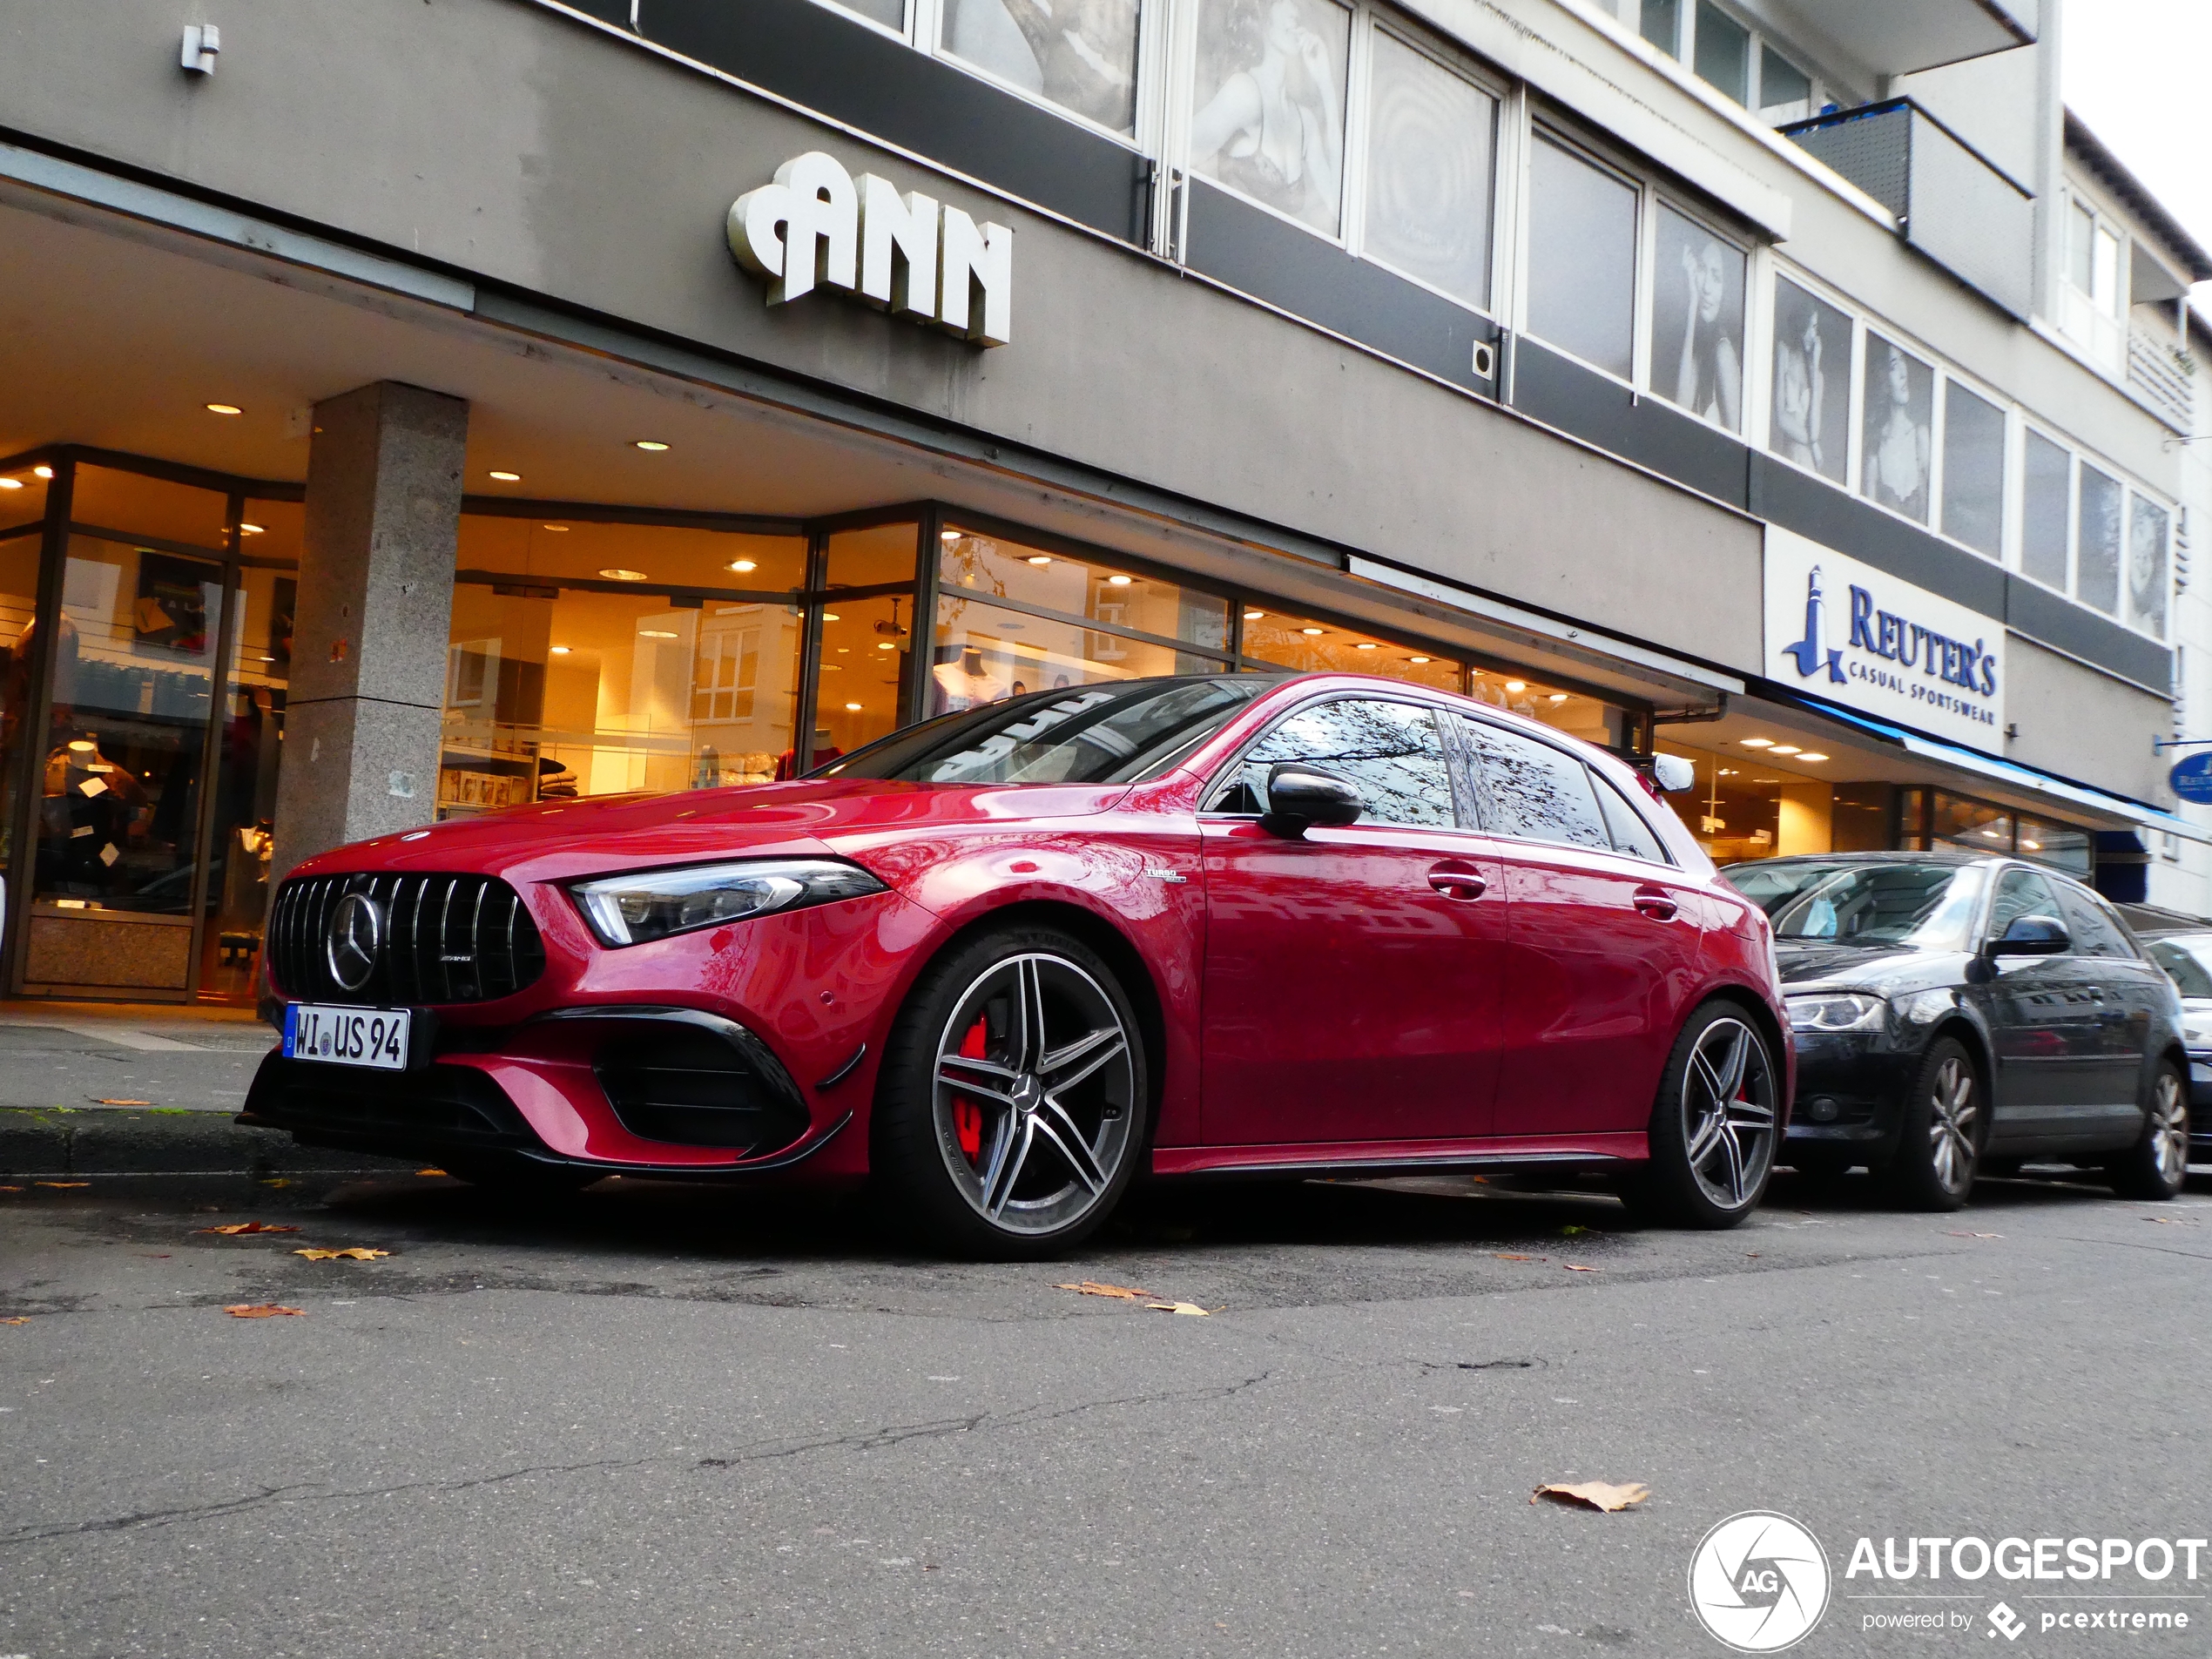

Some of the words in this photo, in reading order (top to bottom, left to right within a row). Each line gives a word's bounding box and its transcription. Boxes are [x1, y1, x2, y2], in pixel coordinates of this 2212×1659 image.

[727, 152, 1012, 348] ANN
[1849, 584, 1996, 698] REUTER'S
[1849, 662, 1905, 694] CASUAL
[1910, 684, 1994, 726] SPORTSWEAR
[296, 1012, 319, 1055] WI
[334, 1015, 365, 1058] US
[371, 1017, 401, 1062] 94
